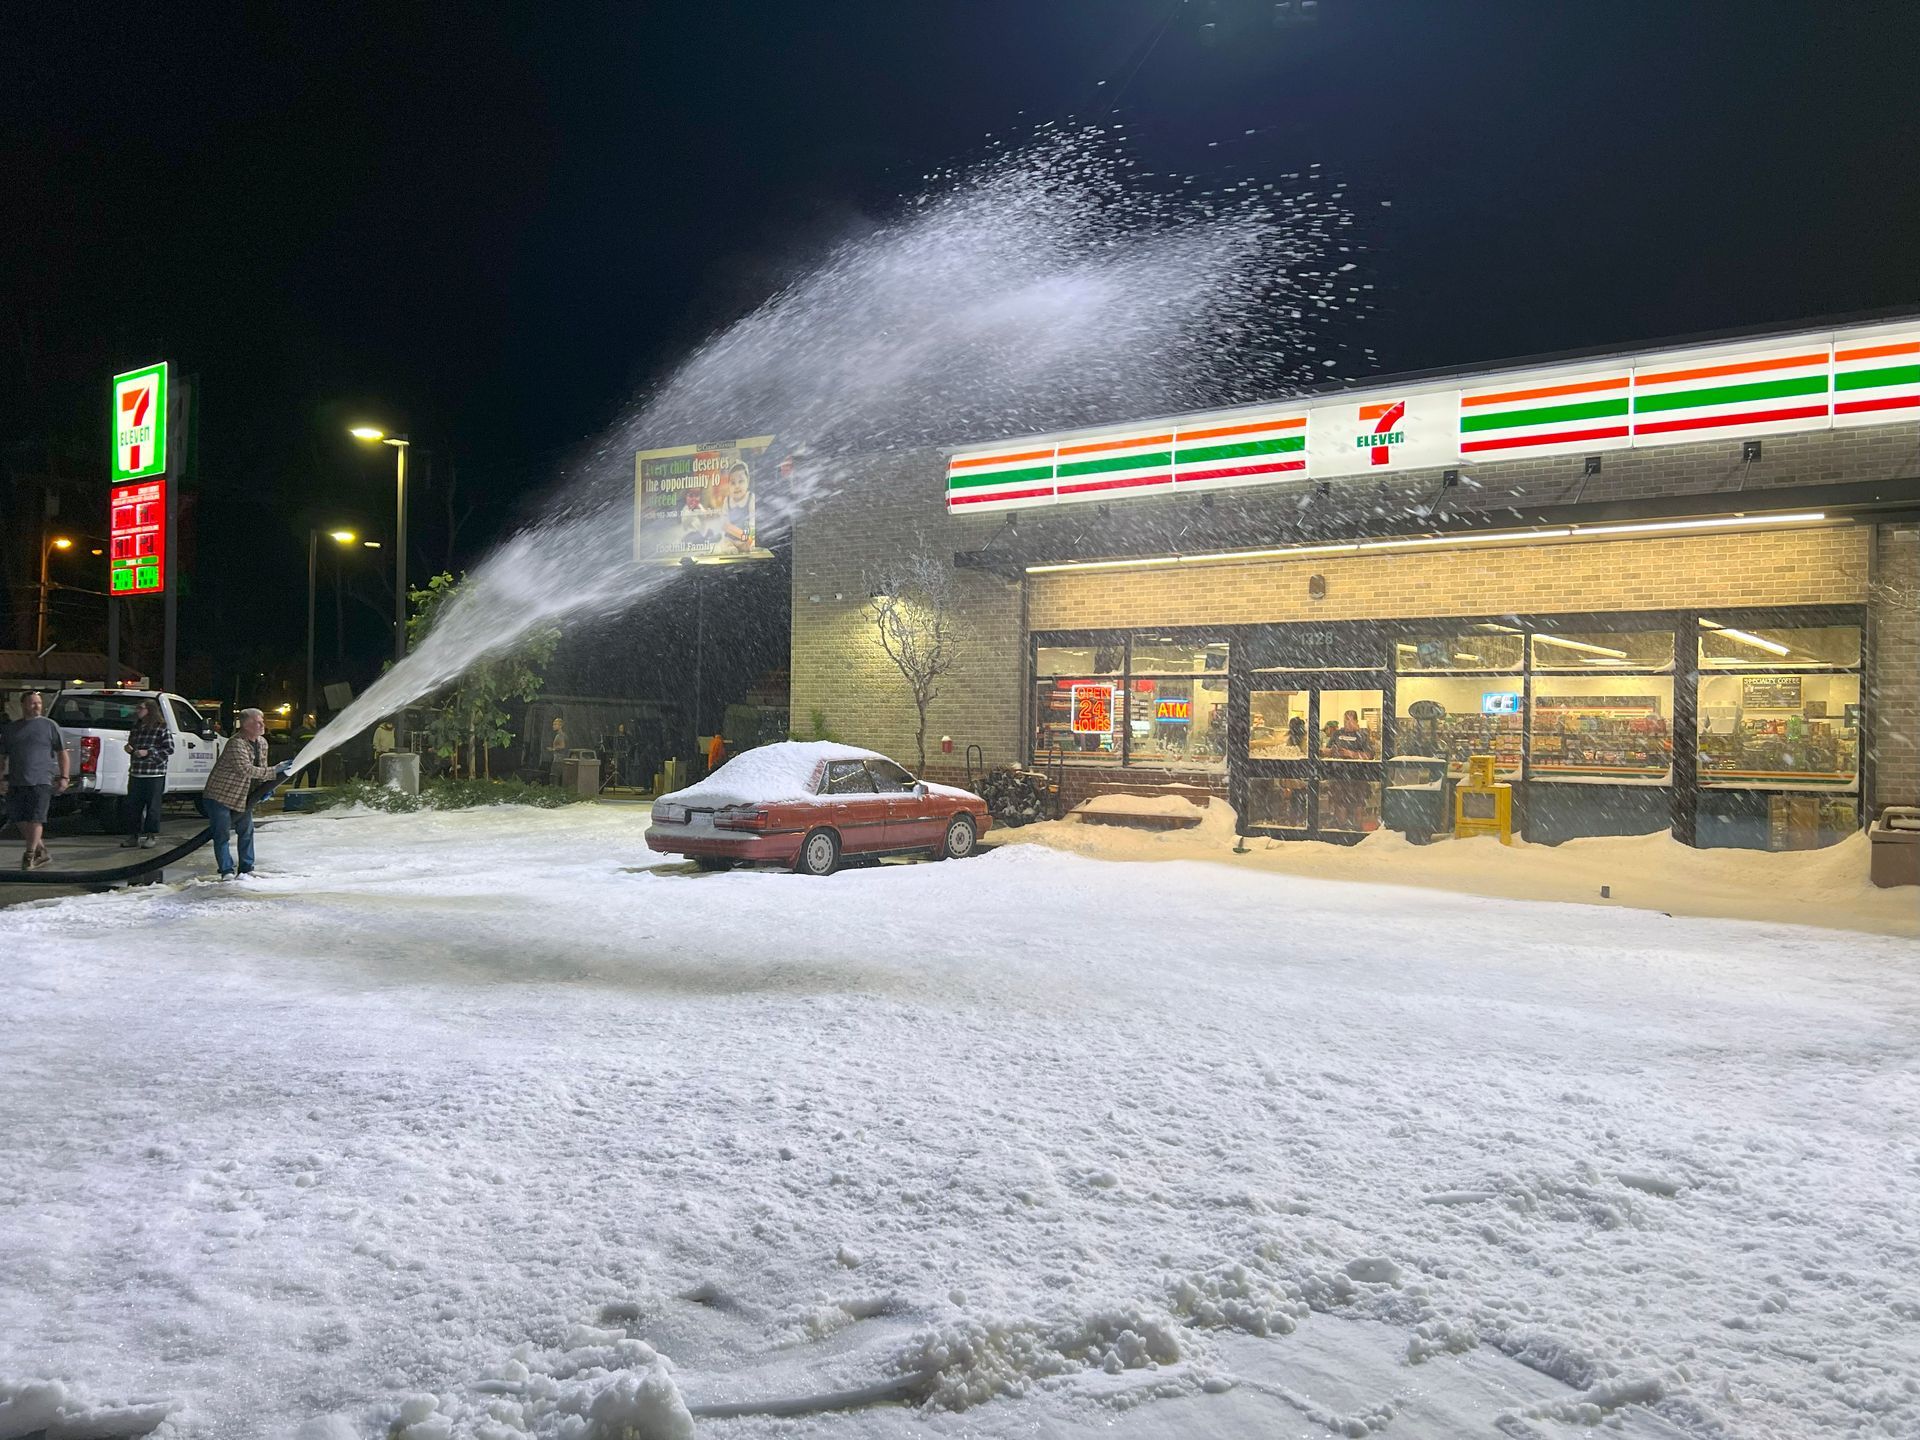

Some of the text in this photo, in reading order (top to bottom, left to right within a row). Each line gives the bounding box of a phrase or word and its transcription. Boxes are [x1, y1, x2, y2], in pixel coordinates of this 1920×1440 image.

[1358, 401, 1405, 466] 7
[670, 459, 690, 475] child
[693, 457, 729, 472] deserves
[646, 473, 720, 493] the opportunity to
[687, 540, 716, 555] Family
[1076, 687, 1110, 699] OPEN
[1079, 699, 1106, 718] 24
[1157, 702, 1188, 718] ATM
[1073, 718, 1111, 731] HOURS
